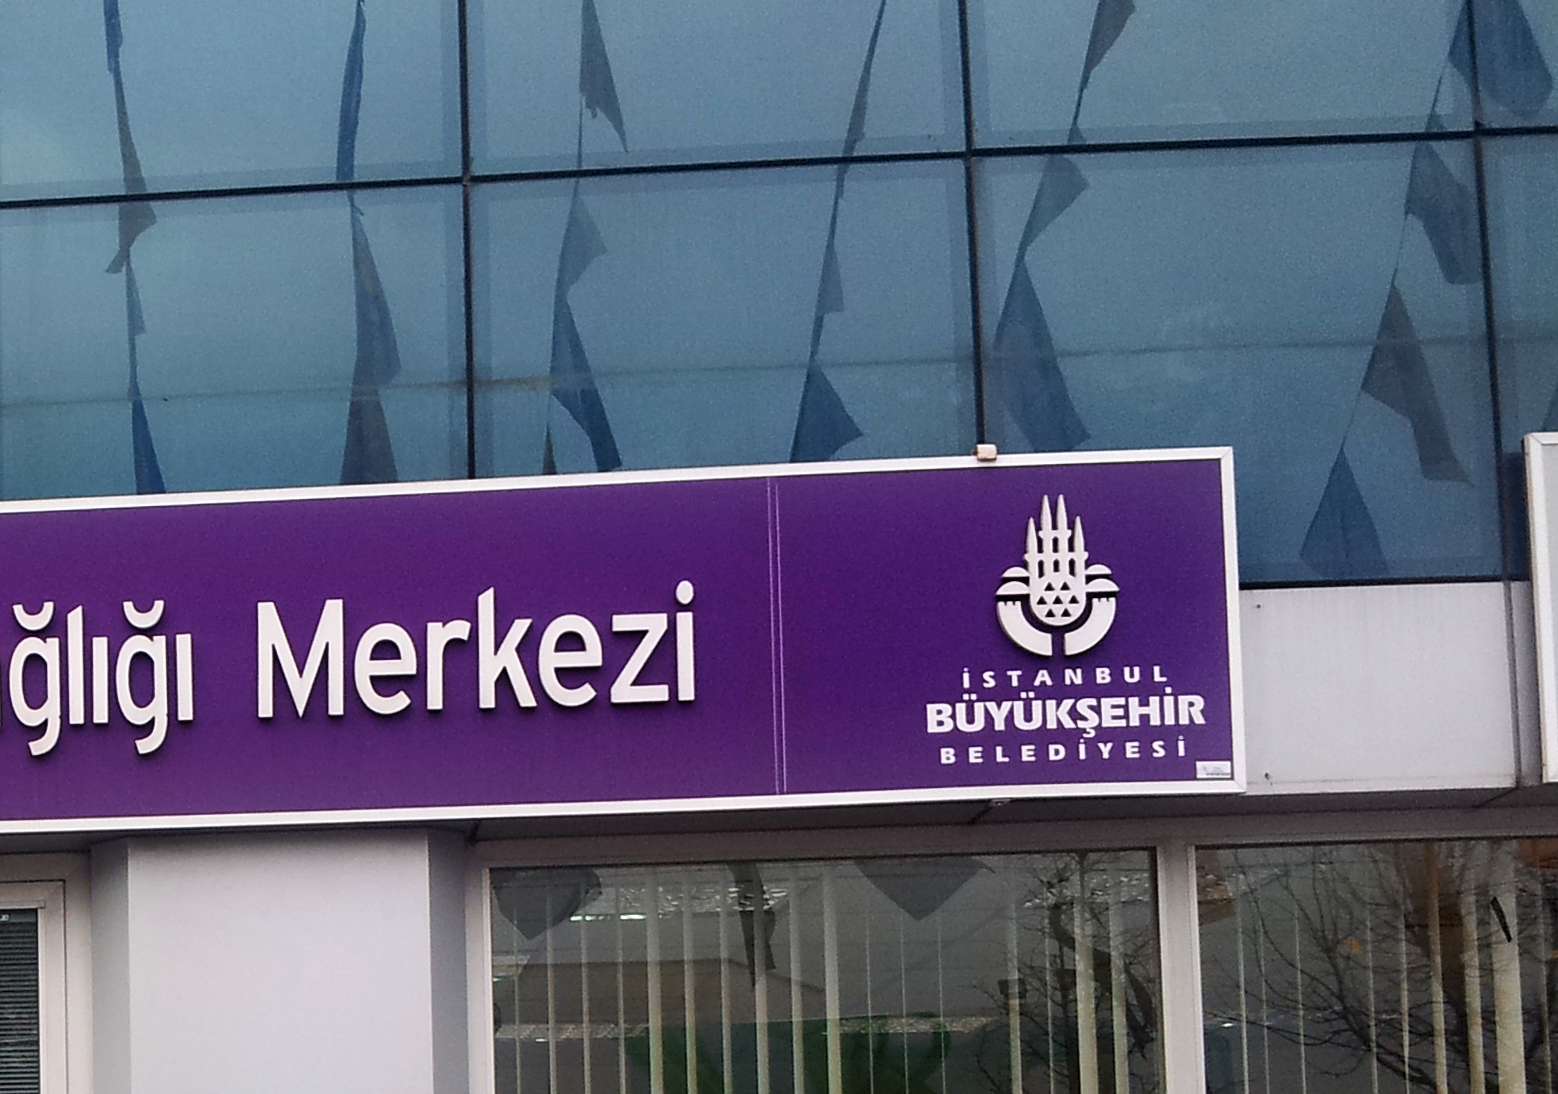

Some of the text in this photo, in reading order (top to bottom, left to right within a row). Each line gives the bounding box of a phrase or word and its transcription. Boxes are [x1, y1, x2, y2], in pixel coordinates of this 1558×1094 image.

[256, 579, 699, 721] Merkezi
[962, 665, 1168, 690] İSTANBUL
[925, 686, 1206, 738] BÜYÜKŞEHİR
[940, 735, 1187, 765] BELEDİYESİ
